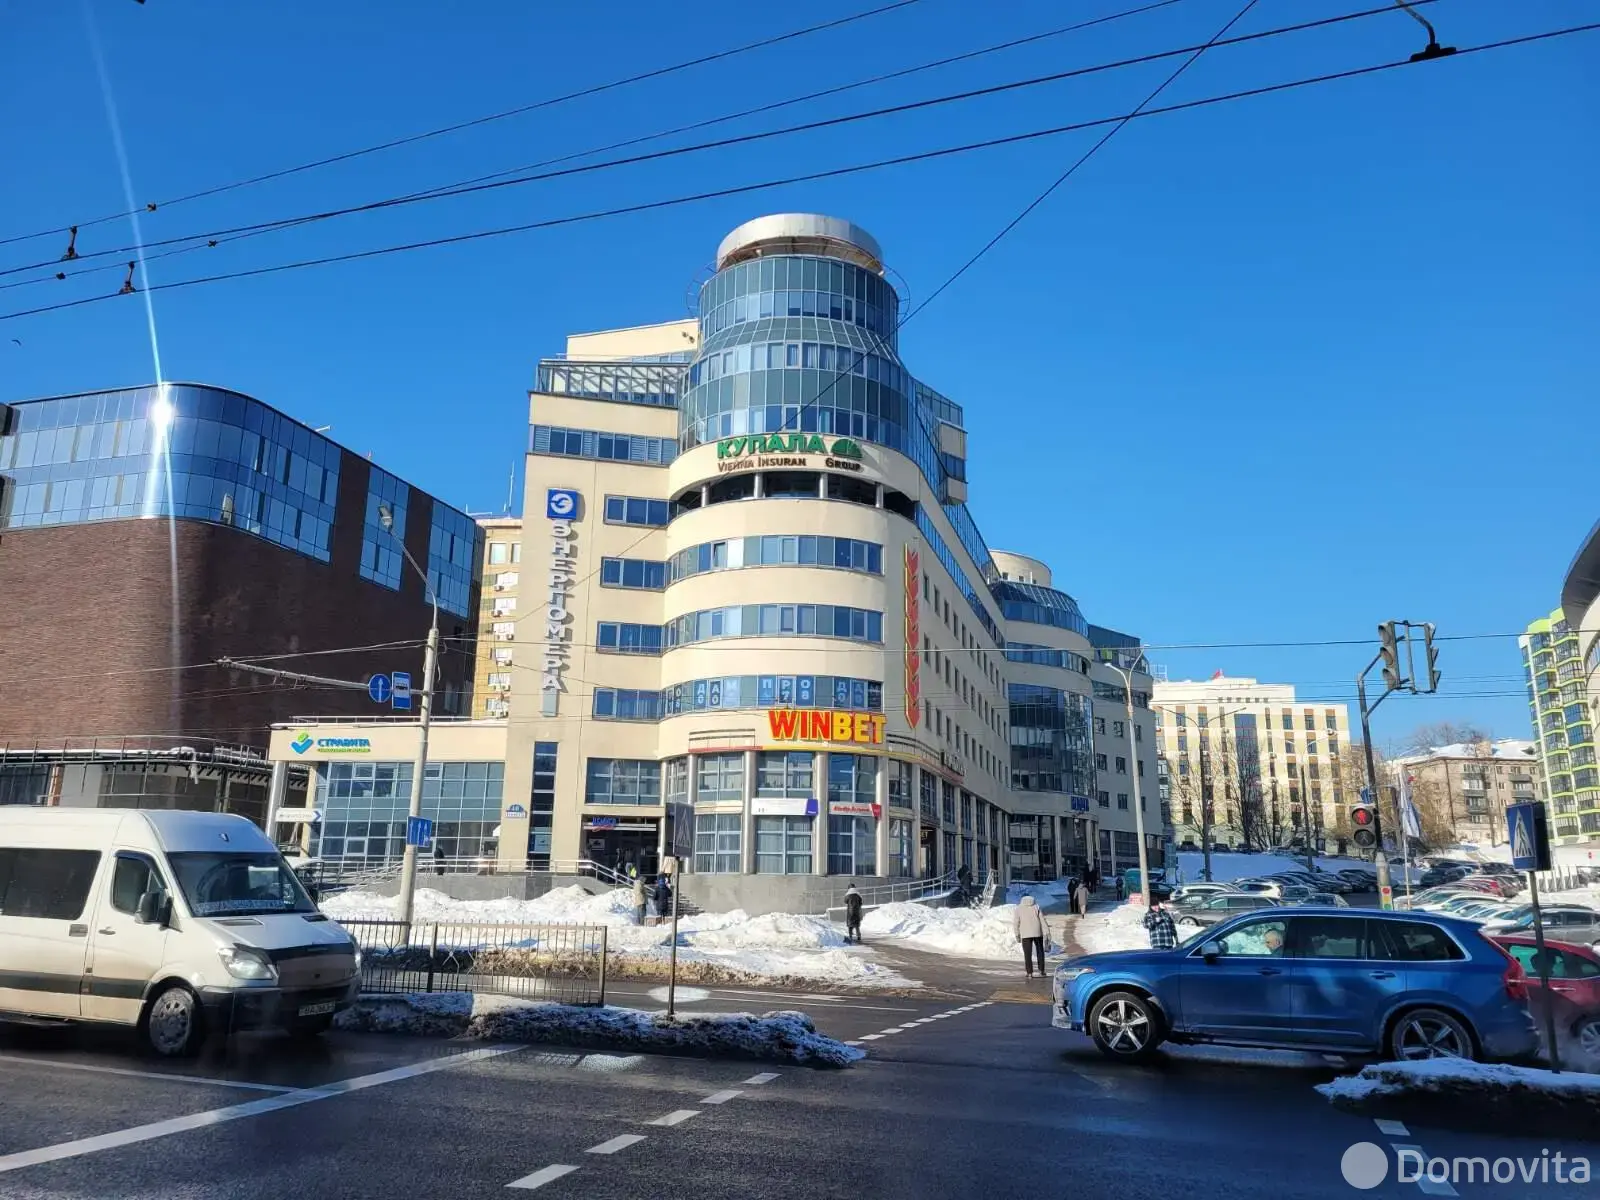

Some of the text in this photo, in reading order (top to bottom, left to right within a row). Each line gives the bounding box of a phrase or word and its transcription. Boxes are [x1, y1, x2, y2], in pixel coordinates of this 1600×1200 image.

[717, 433, 828, 459] КУПАЛА
[542, 520, 572, 690] ЭНЕРГОМЕРА
[768, 709, 887, 743] WINBET
